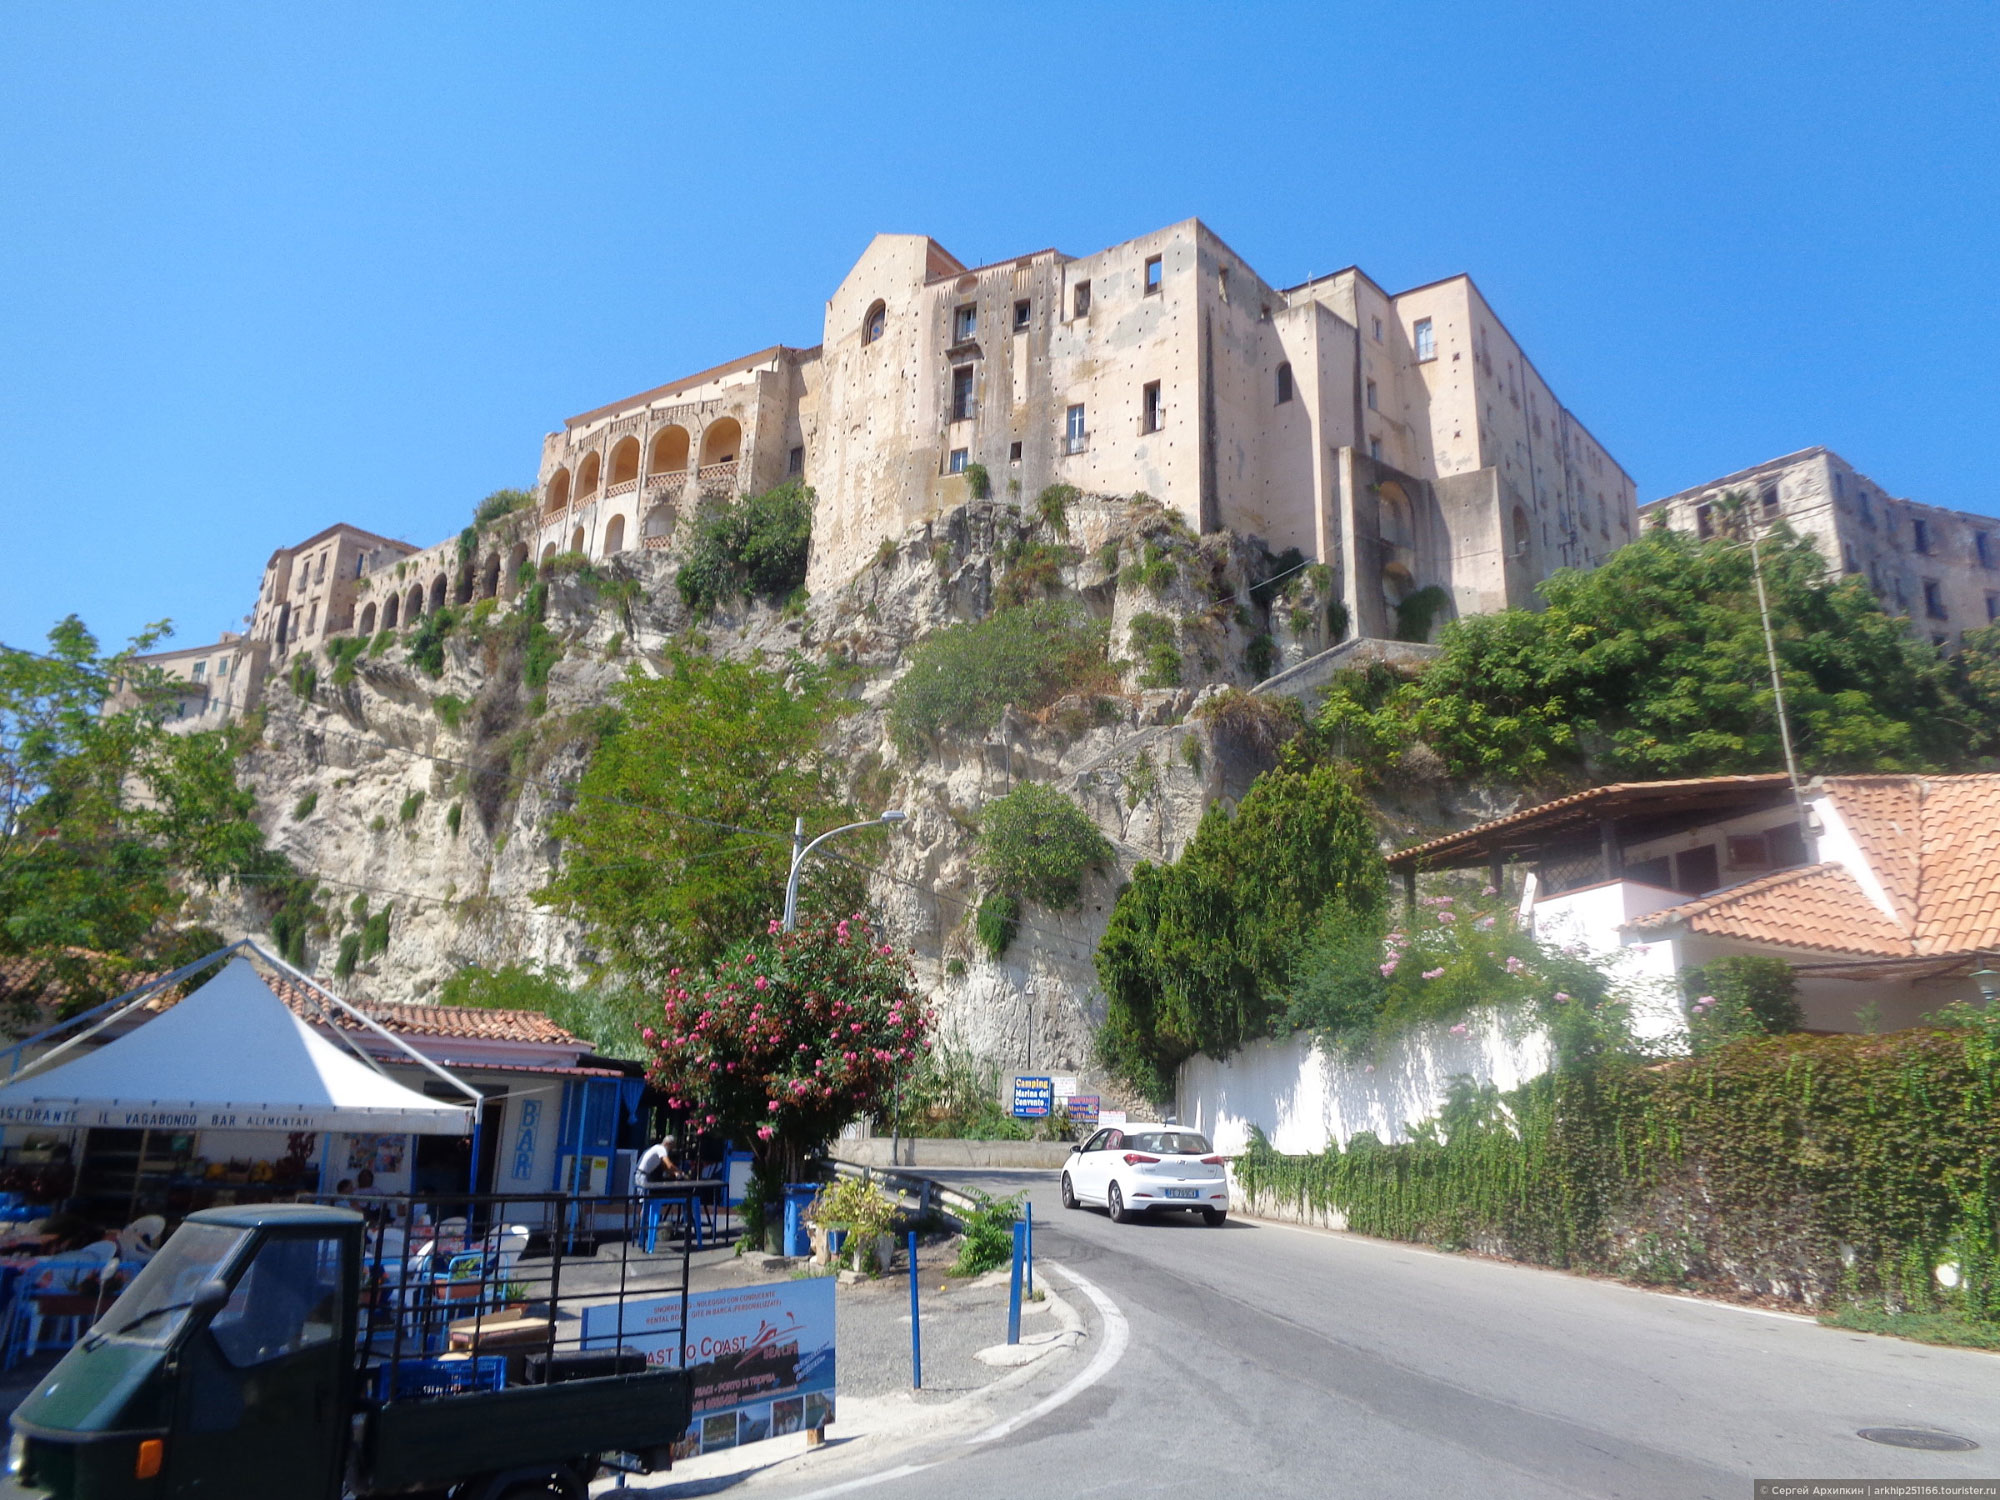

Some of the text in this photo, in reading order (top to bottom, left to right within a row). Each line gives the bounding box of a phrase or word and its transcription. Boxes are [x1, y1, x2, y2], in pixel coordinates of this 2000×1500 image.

[1015, 1078, 1048, 1089] Camping
[1015, 1089, 1038, 1098] Marina
[1014, 1098, 1045, 1107] Convento
[0, 1107, 314, 1127] ISTORANTE IL VAGABONDO BAR ALIMENTARI
[515, 1100, 537, 1178] BAR
[727, 1296, 739, 1304] CON
[646, 1315, 670, 1325] RENTAL
[646, 1347, 674, 1366] AST
